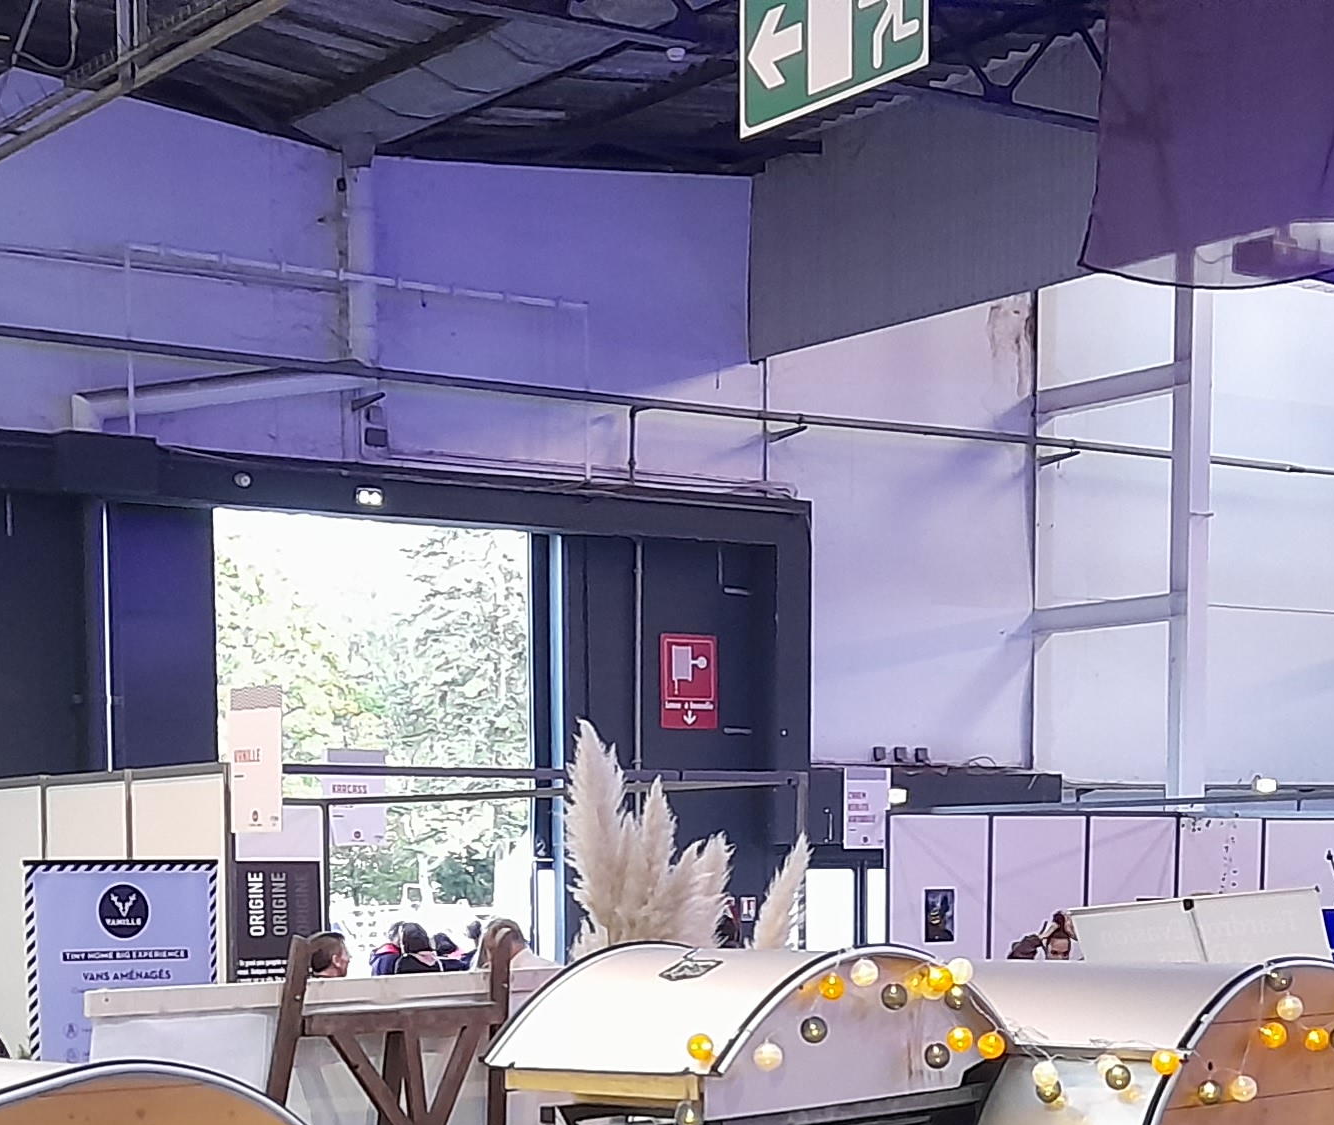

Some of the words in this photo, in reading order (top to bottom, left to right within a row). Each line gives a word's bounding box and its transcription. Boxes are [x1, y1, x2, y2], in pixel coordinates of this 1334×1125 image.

[248, 872, 265, 937] ORIGINE
[271, 872, 288, 937] ORIGINE
[105, 918, 142, 927] VANILLE
[87, 952, 114, 960] HOME
[115, 951, 131, 960] BIG
[132, 949, 185, 960] EXPERIENCE
[82, 971, 110, 981] VANS
[112, 968, 171, 981] AMÉNAGÉS
